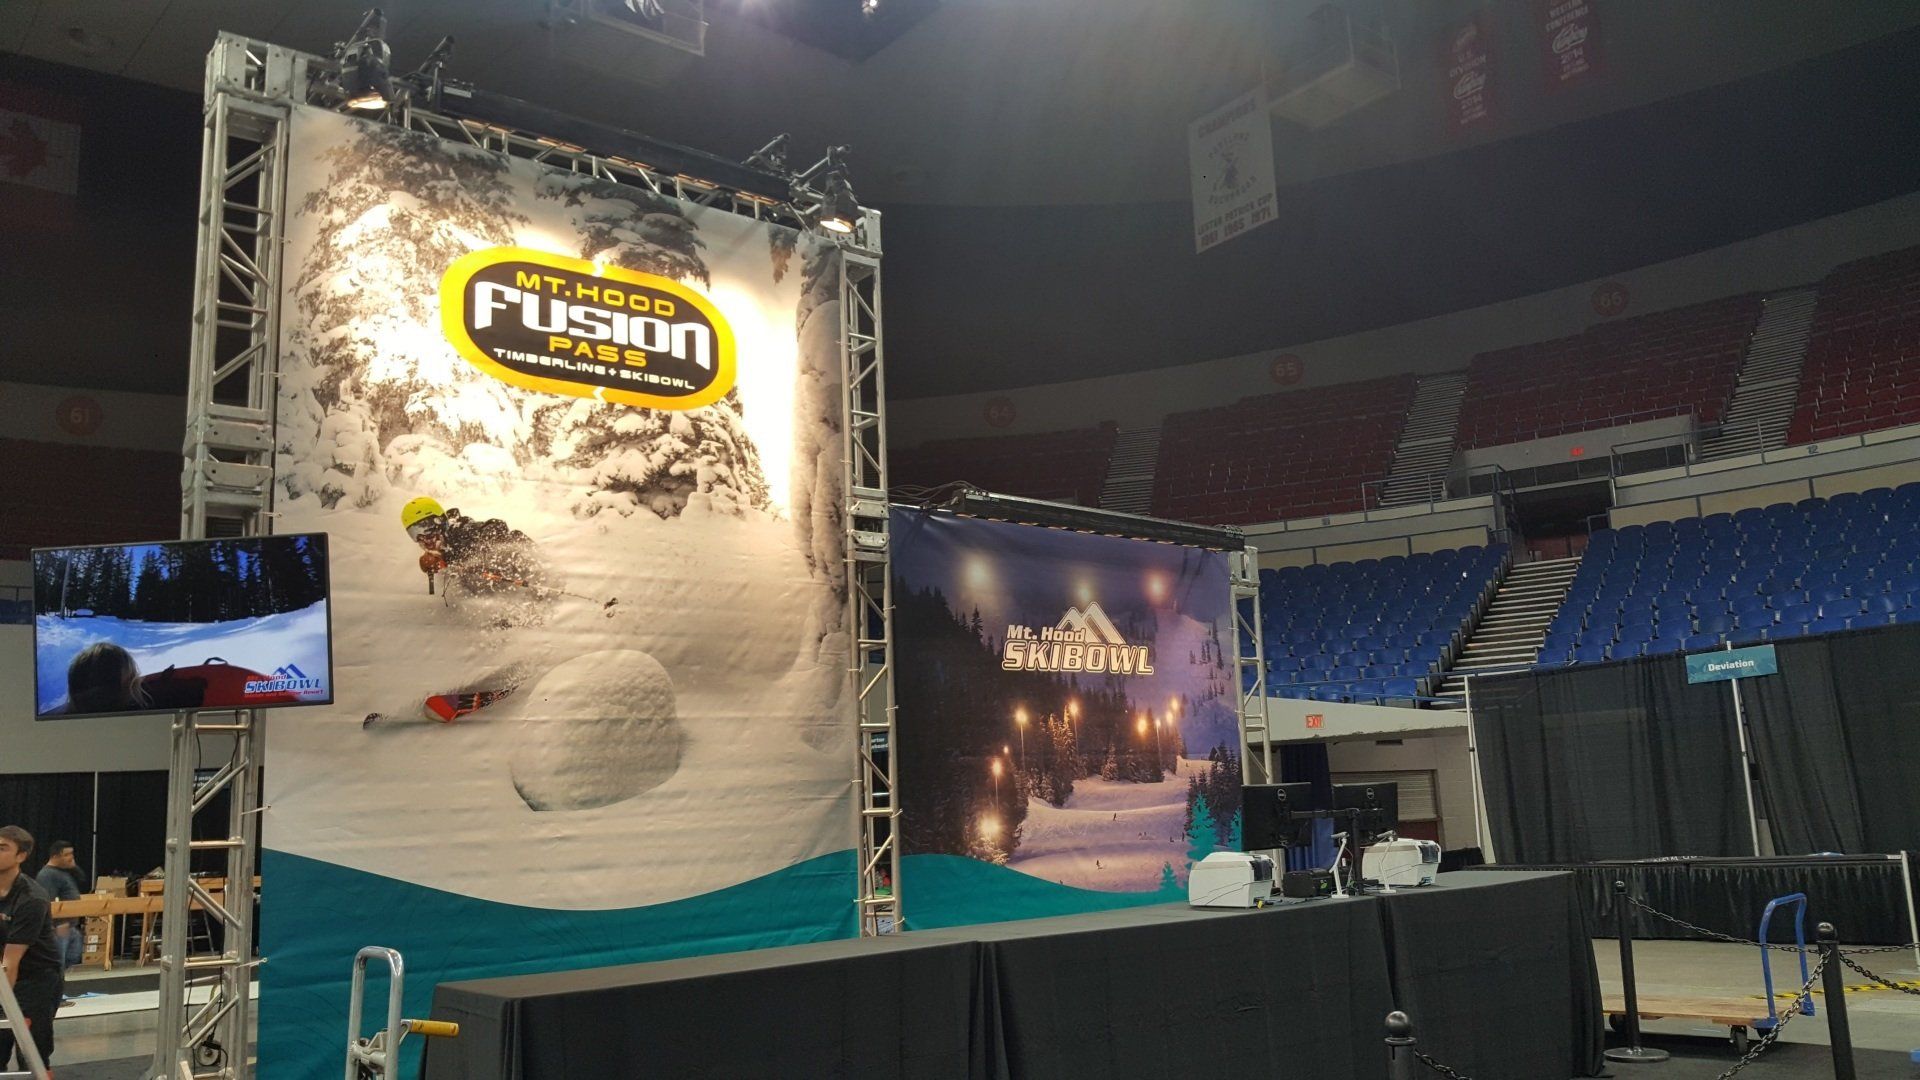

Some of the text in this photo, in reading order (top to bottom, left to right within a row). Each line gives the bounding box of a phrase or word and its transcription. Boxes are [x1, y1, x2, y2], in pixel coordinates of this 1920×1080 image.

[549, 335, 647, 367] PASS
[493, 347, 606, 376] TIMBERLINE
[619, 369, 696, 390] SKIBOWL
[1275, 361, 1297, 377] 65
[1007, 624, 1087, 642] Mt. Hood
[1001, 639, 1155, 675] SKIBOWL
[1708, 659, 1756, 672] Deviation
[245, 679, 320, 693] SKIBOWL
